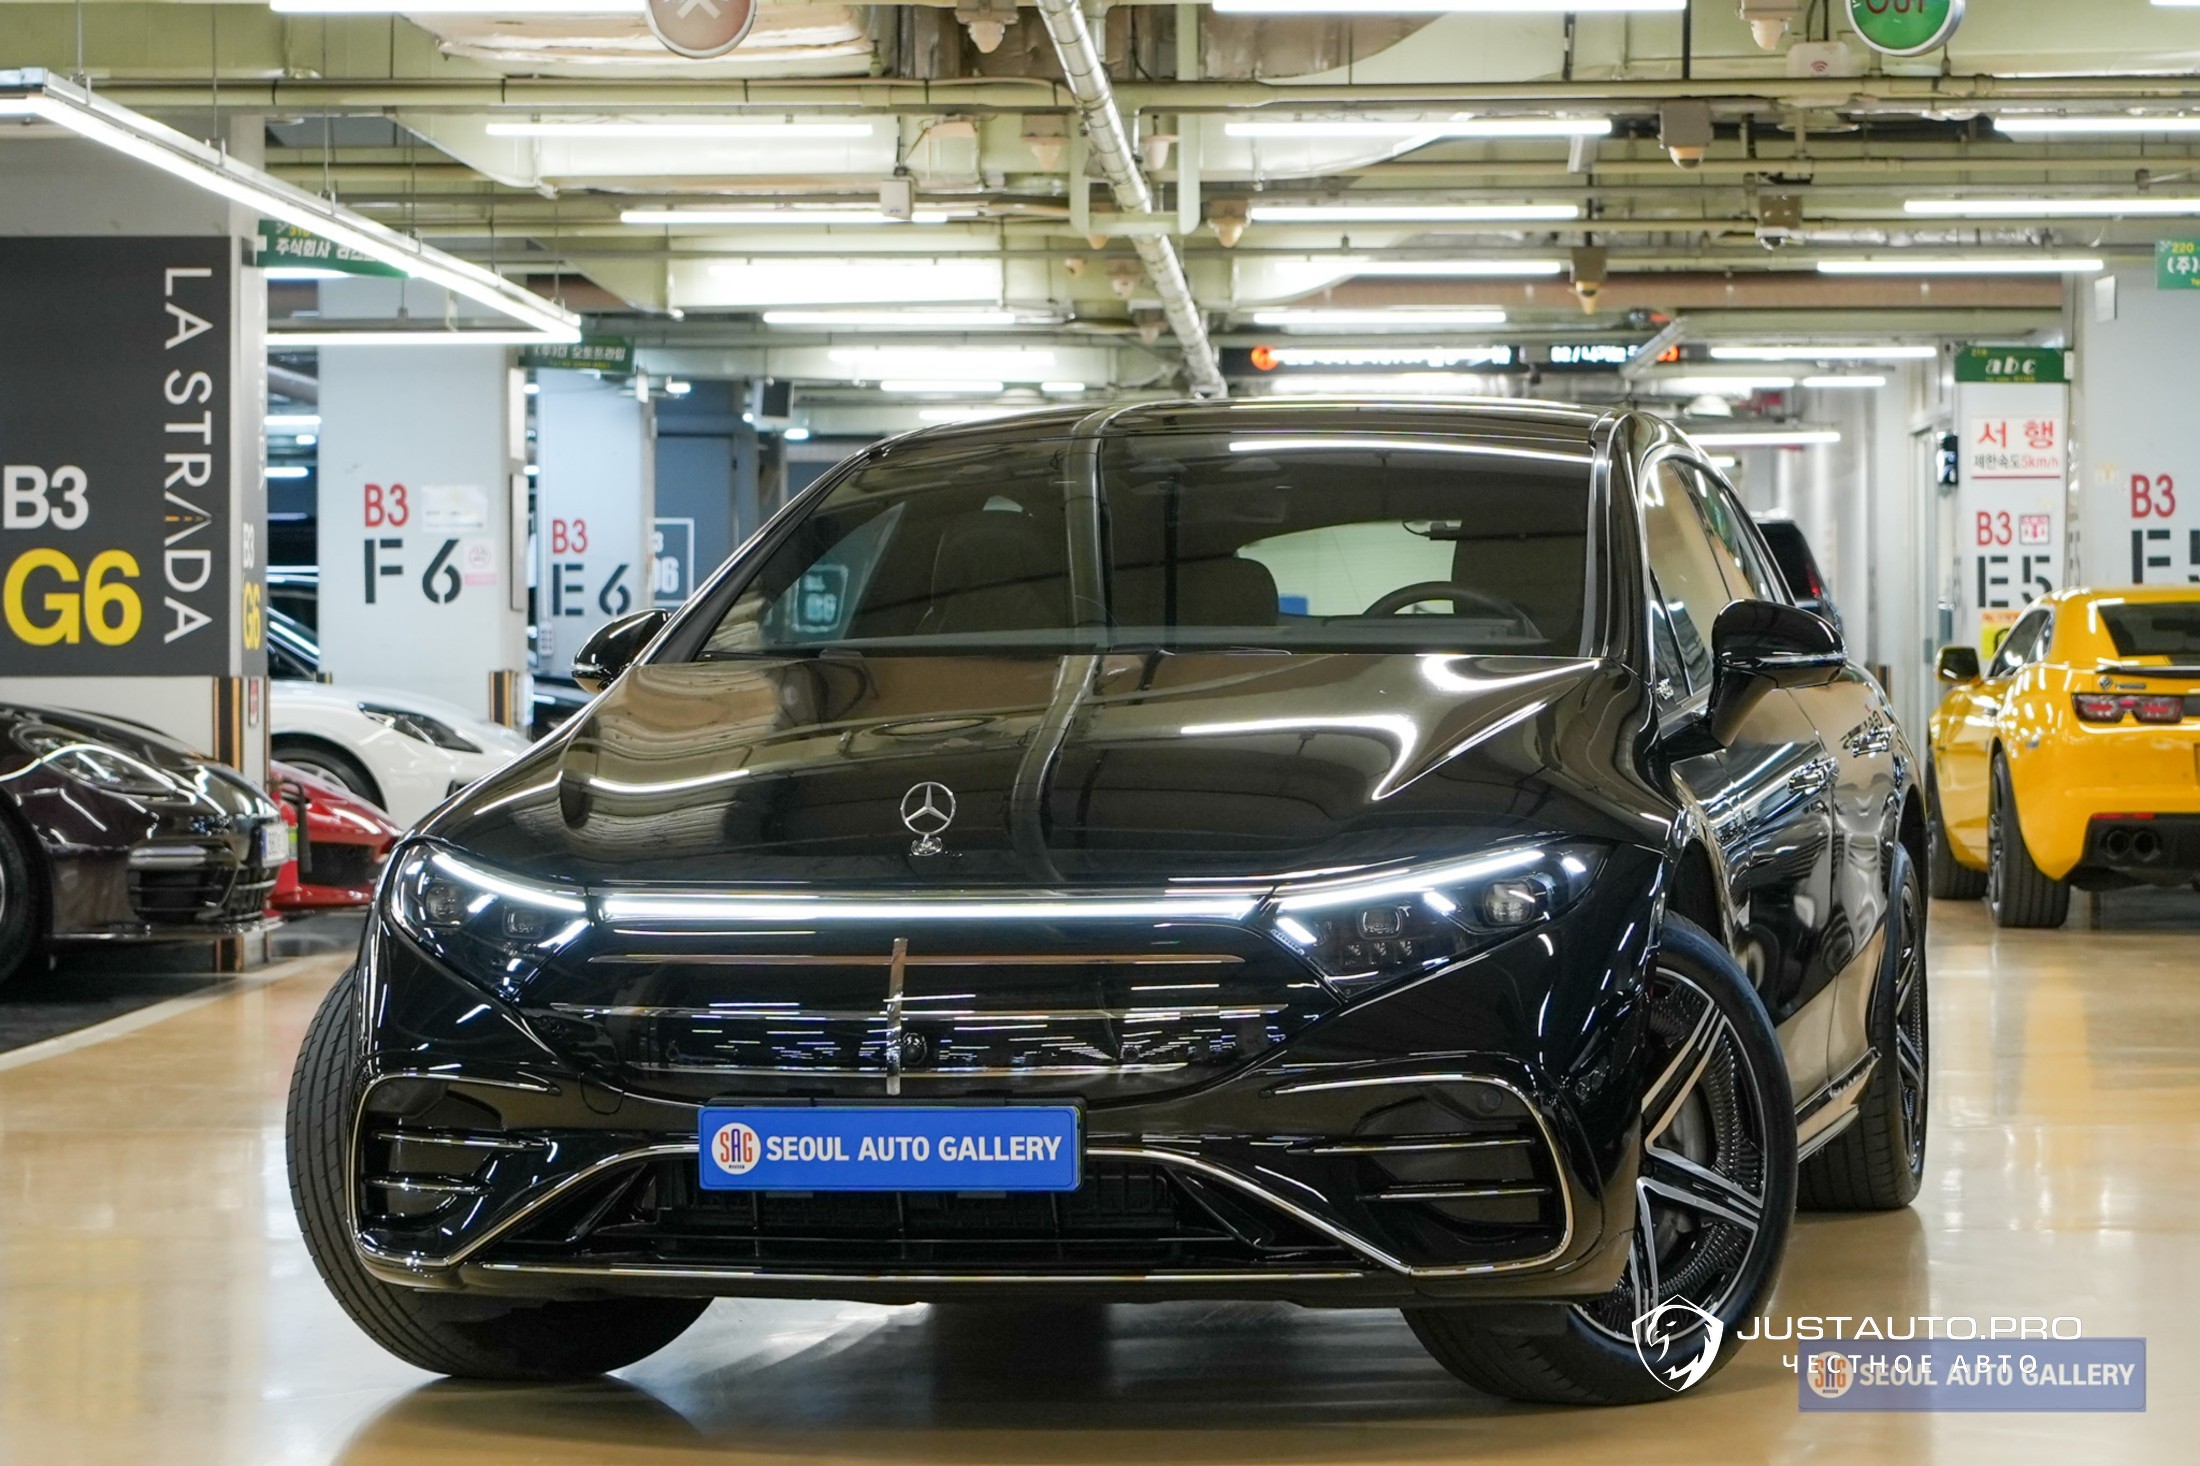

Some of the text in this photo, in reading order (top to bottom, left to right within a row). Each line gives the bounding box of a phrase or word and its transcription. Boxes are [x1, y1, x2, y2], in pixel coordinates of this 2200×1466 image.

[276, 237, 331, 258] 주식회사
[2172, 242, 2194, 254] 220
[1985, 356, 2036, 375] abc
[164, 268, 212, 643] LA STRADA
[4, 465, 89, 530] B3
[365, 484, 409, 527] B3
[2131, 474, 2176, 518] B3
[242, 522, 255, 569] B3
[552, 519, 588, 554] B3
[1977, 512, 2012, 546] B3
[3, 548, 143, 646] G6
[243, 582, 261, 650] G6
[720, 1129, 1062, 1162] SAG SEOUL AUTO GALLERY
